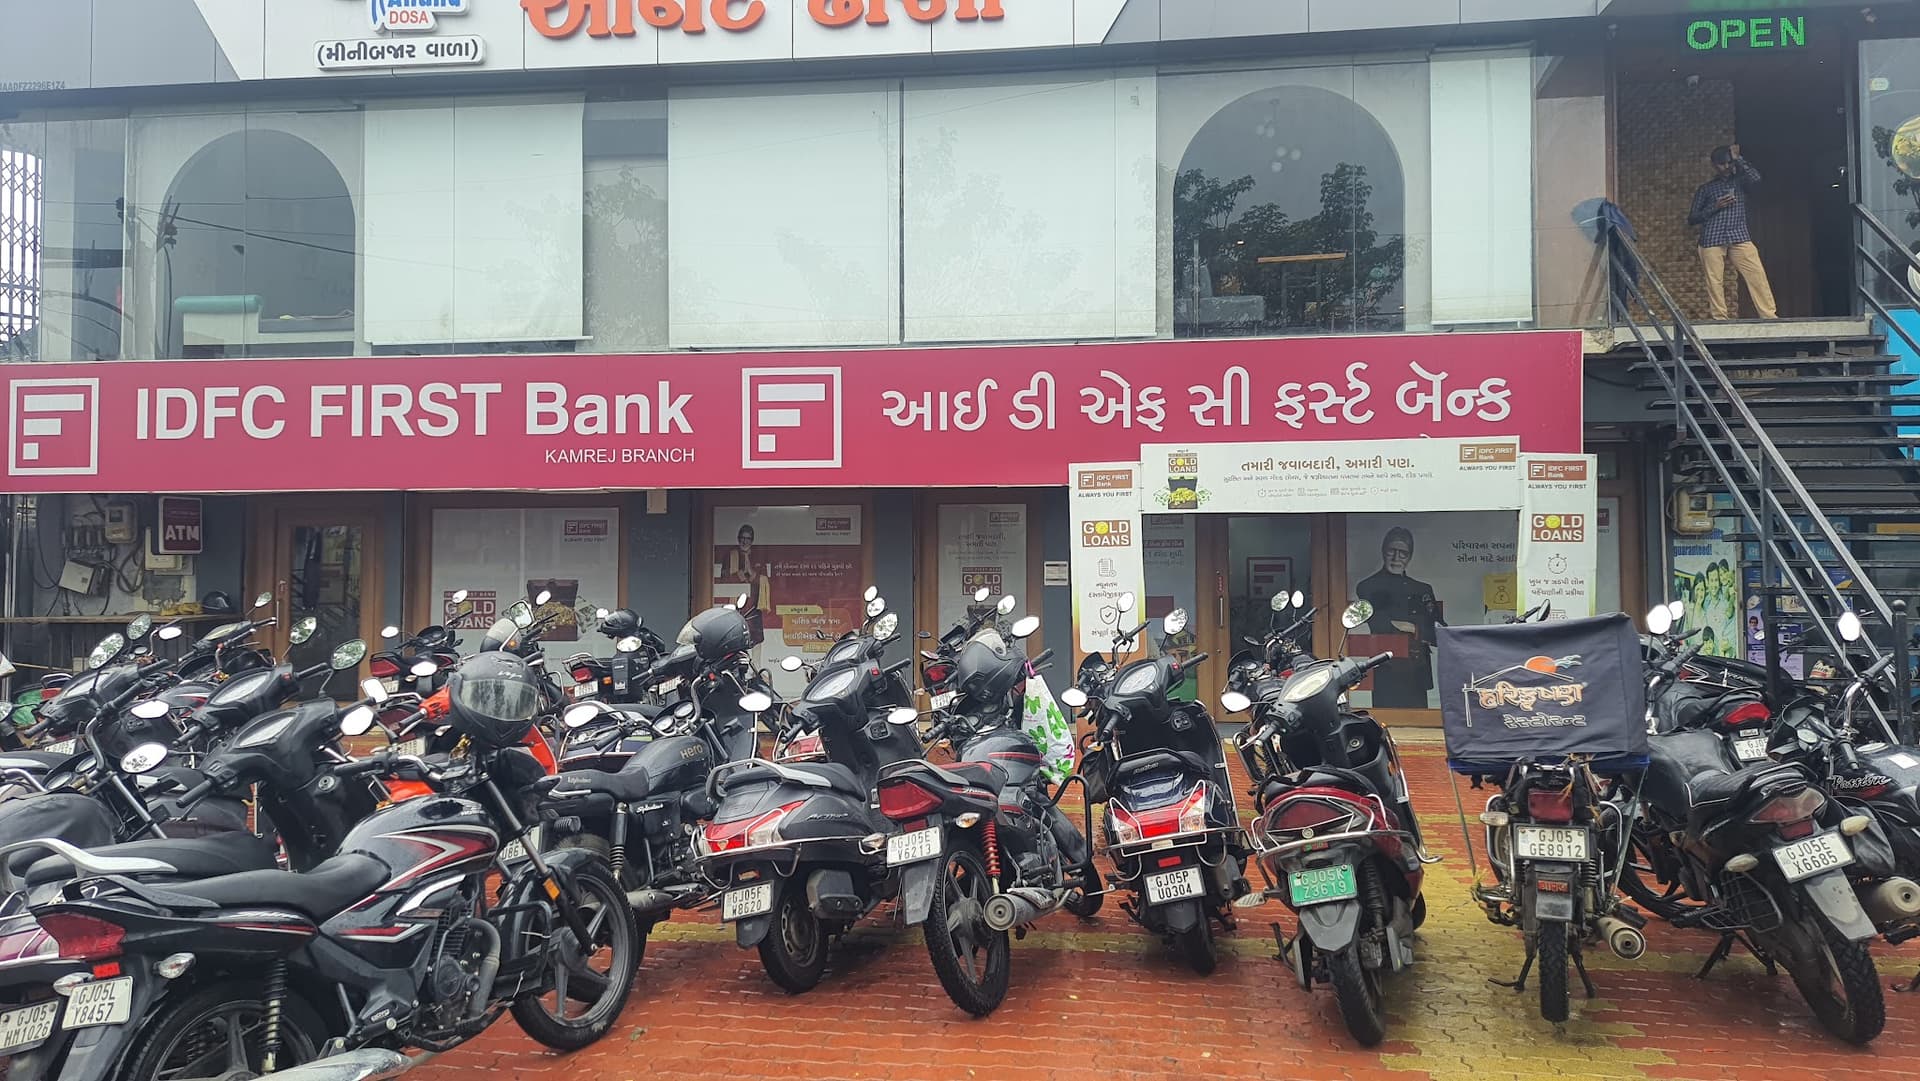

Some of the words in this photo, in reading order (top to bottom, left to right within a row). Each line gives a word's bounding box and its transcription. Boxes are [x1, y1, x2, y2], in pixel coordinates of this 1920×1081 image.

[389, 11, 429, 24] DOSA
[1686, 16, 1805, 50] OPEN
[317, 41, 416, 67] (મીનીબજાર
[426, 38, 479, 61] વાળા)
[881, 378, 998, 432] આઈ
[1008, 371, 1056, 430] ડી
[1080, 370, 1167, 433] એફ
[1187, 366, 1251, 427] સી
[1274, 362, 1375, 429] ફર્સ્ટ
[136, 385, 286, 440] IDFC
[310, 382, 502, 438] FIRST
[526, 381, 694, 435] Bank
[545, 449, 616, 463] KAMREJ
[622, 448, 695, 463] BRANCH
[1241, 457, 1274, 472] તમારી
[1278, 456, 1340, 471] જવાબદારી,
[1345, 455, 1382, 470] અમારી
[1083, 521, 1129, 535] GOLD
[1533, 515, 1583, 529] GOLD
[165, 525, 200, 541] ATM
[1084, 535, 1130, 546] LOANS
[1532, 530, 1583, 541] LOANS
[897, 830, 931, 848] GJ05E
[1539, 829, 1573, 843] GJ05
[898, 843, 931, 861] V6213
[1530, 843, 1582, 858] GE8912
[1785, 837, 1830, 860] GJ05E
[1793, 850, 1838, 875] X6685
[1155, 870, 1189, 888] GJ05P
[1301, 868, 1345, 885] GJ05K
[1158, 883, 1192, 900] U0304
[1304, 881, 1347, 899] Z3619
[79, 982, 117, 1005] GJ05L
[17, 1005, 49, 1027] GJ05
[72, 1003, 114, 1026] Y8457
[4, 1021, 51, 1047] HM1026
